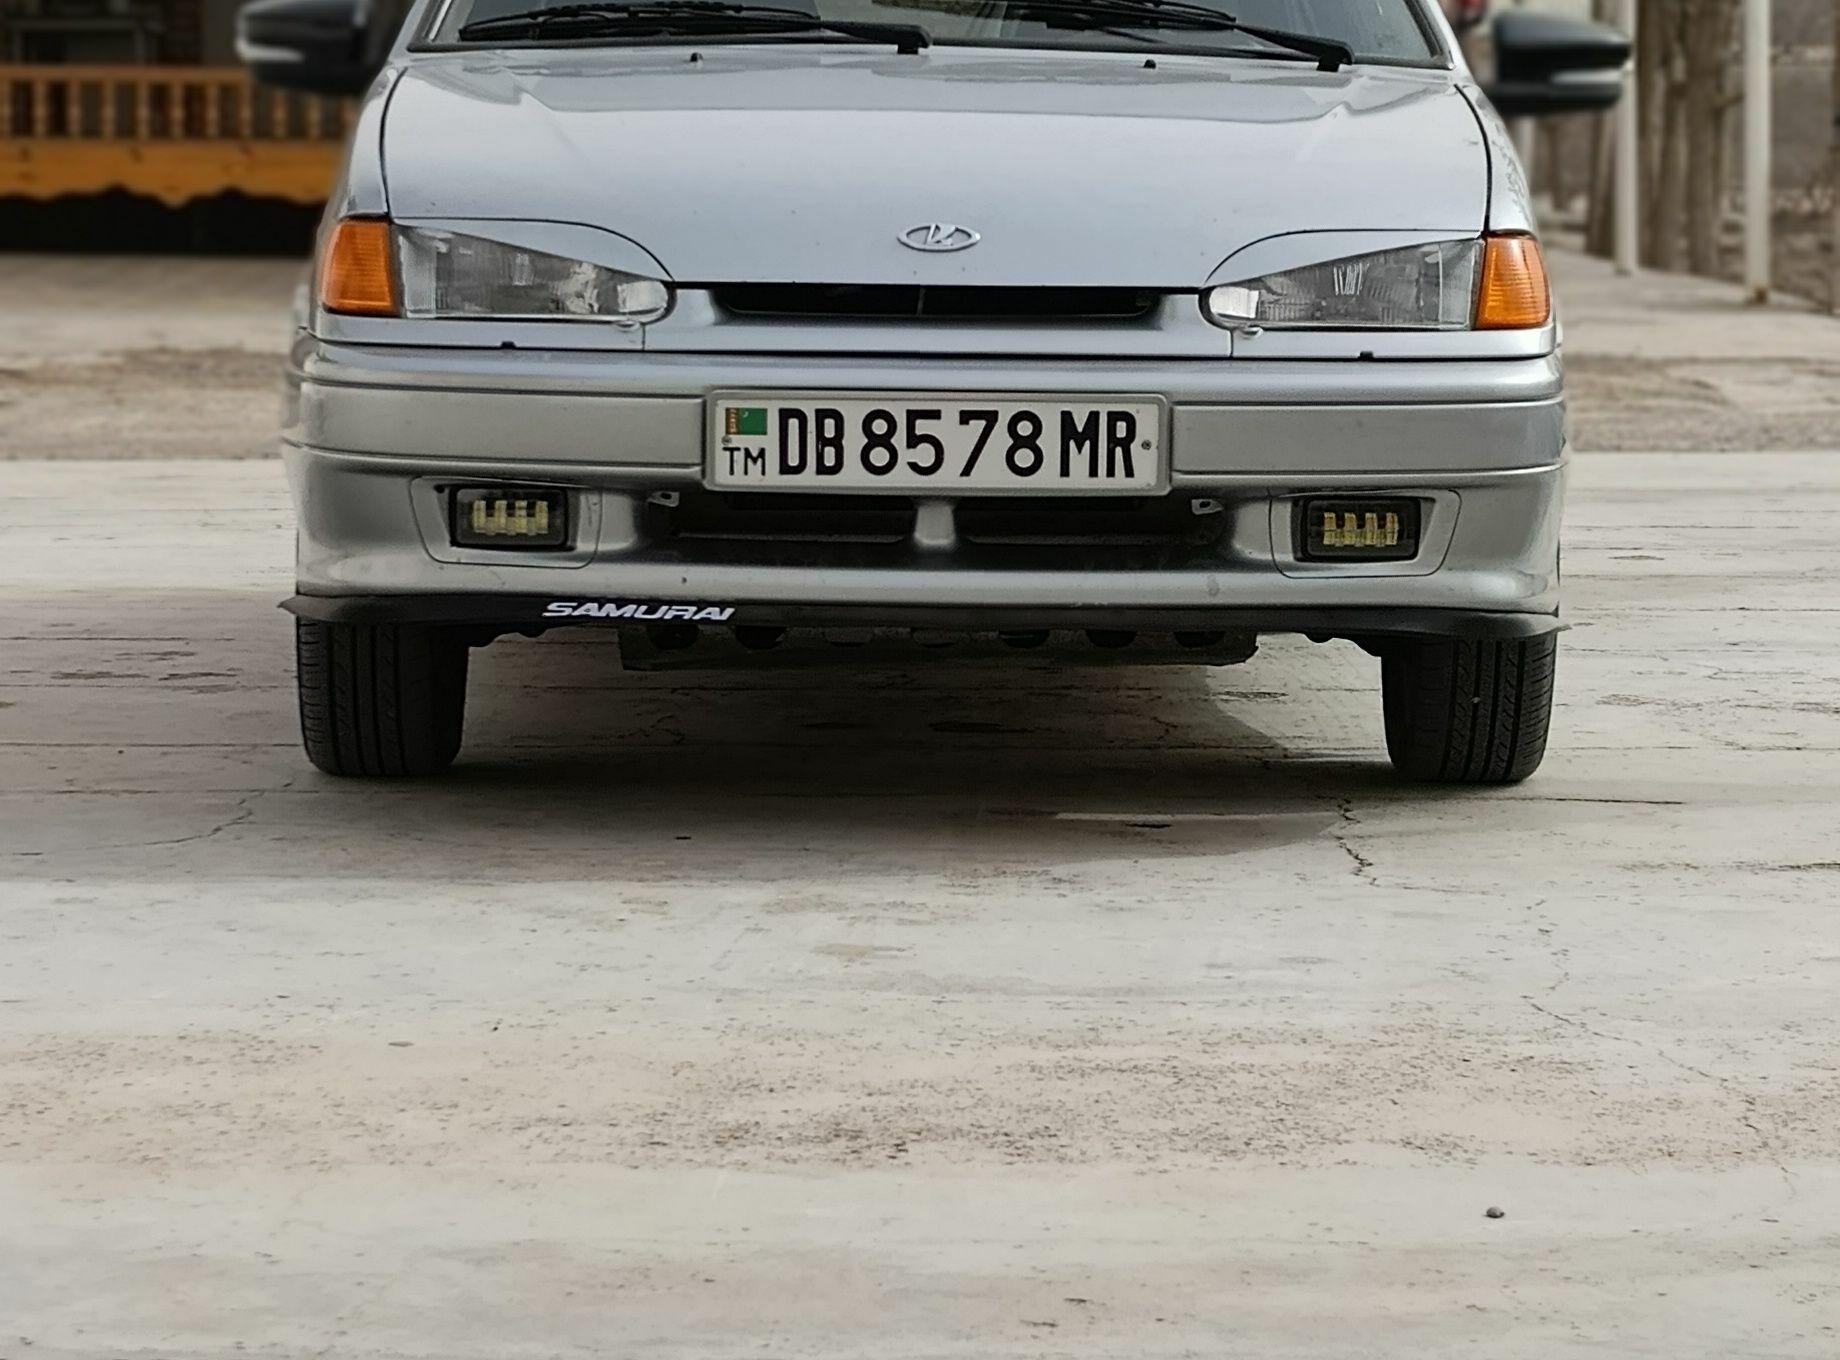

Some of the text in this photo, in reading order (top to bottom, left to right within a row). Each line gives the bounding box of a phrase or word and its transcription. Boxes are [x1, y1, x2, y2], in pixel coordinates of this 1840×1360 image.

[778, 407, 1137, 478] DB 8578 MR
[723, 446, 767, 476] TM
[542, 602, 735, 621] SAMURAI
